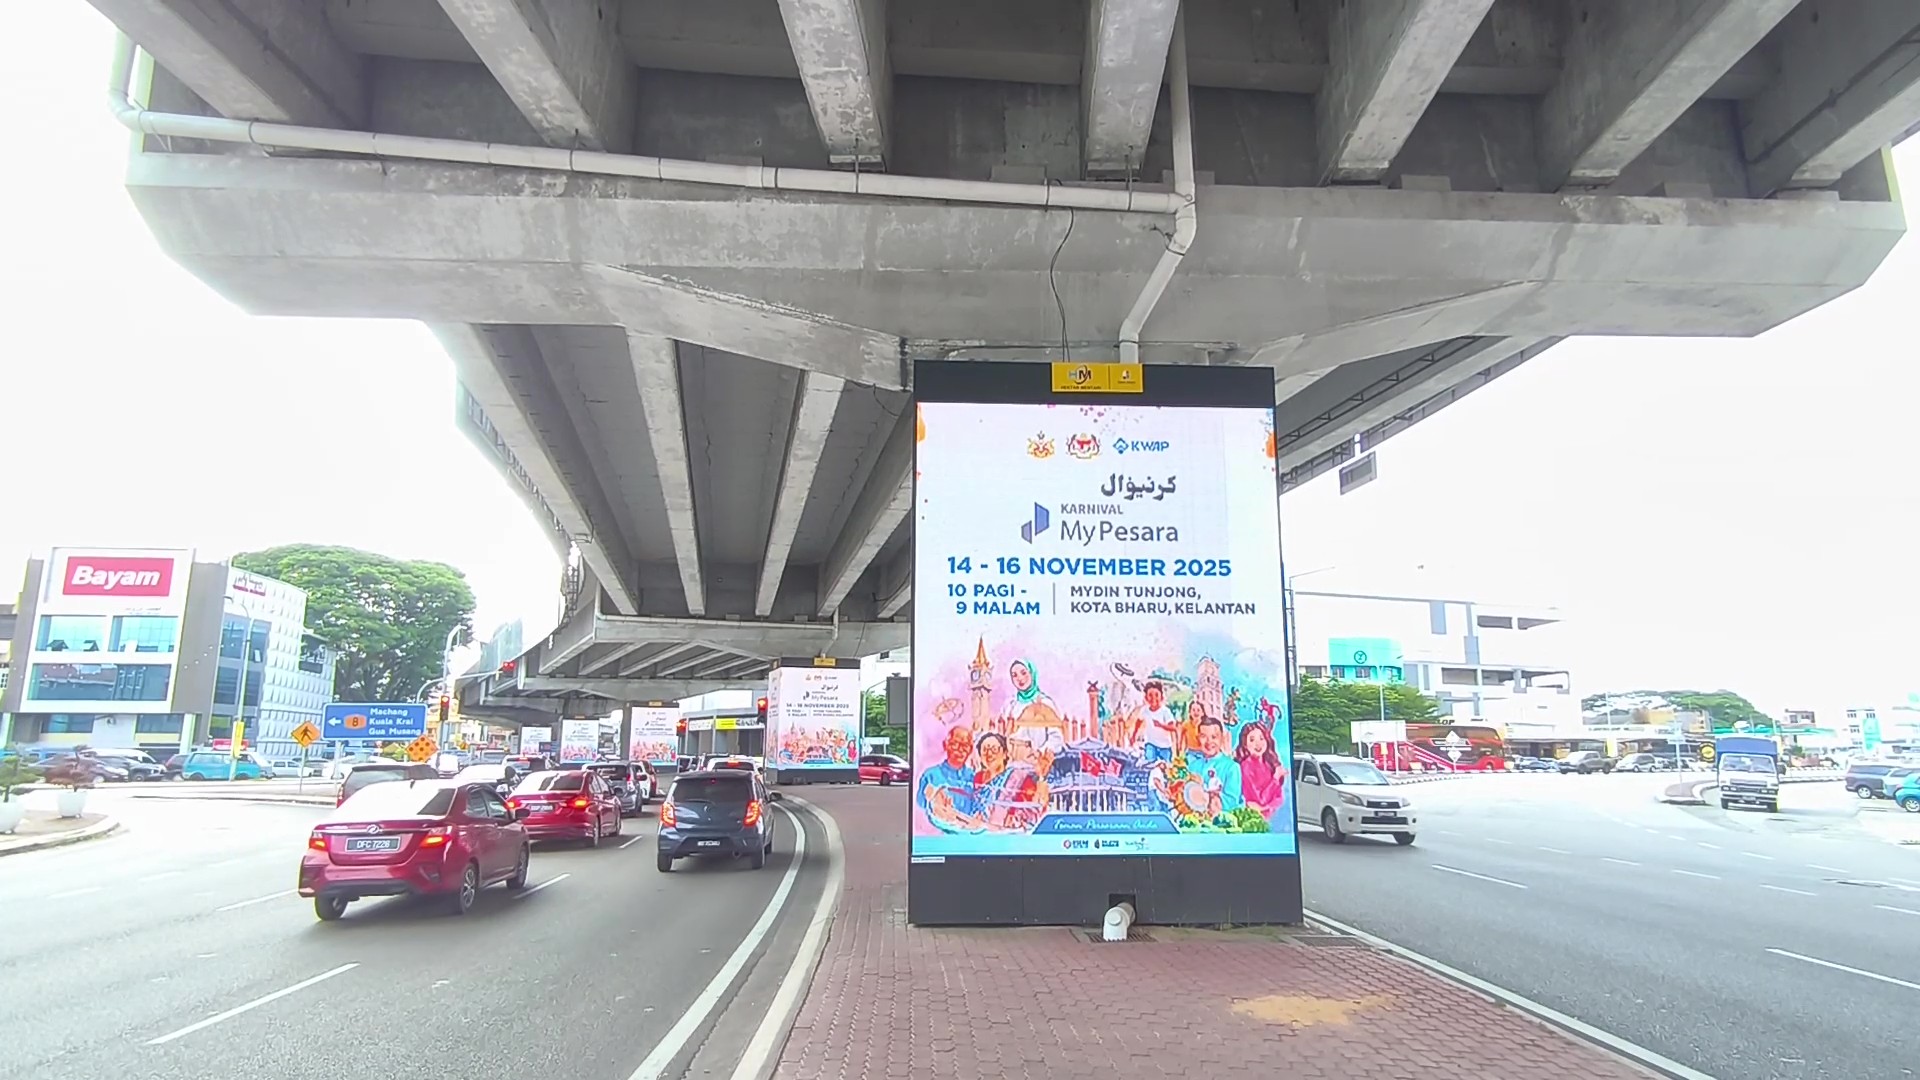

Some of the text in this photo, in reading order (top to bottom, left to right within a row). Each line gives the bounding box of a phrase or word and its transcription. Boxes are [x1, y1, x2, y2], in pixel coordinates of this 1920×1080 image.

[1131, 440, 1169, 451] KWAP
[1061, 503, 1123, 515] KARNIVAL
[1060, 520, 1178, 546] MyPesara
[947, 556, 972, 574] 14
[996, 557, 1021, 574] 16
[1029, 557, 1166, 576] NOVEMBER
[1173, 559, 1232, 576] 2025
[71, 565, 160, 590] Bayam
[947, 583, 967, 597] 10
[973, 584, 1014, 597] PAGI
[1070, 585, 1201, 600] MYDIN TUNJONG,
[956, 601, 1040, 615] 9 MALAM
[1070, 601, 1256, 616] KOTA BHARU, KELANTAN
[370, 707, 408, 716] Machang
[352, 717, 359, 727] 8
[369, 717, 394, 725] Kuala
[389, 728, 421, 736] Musang
